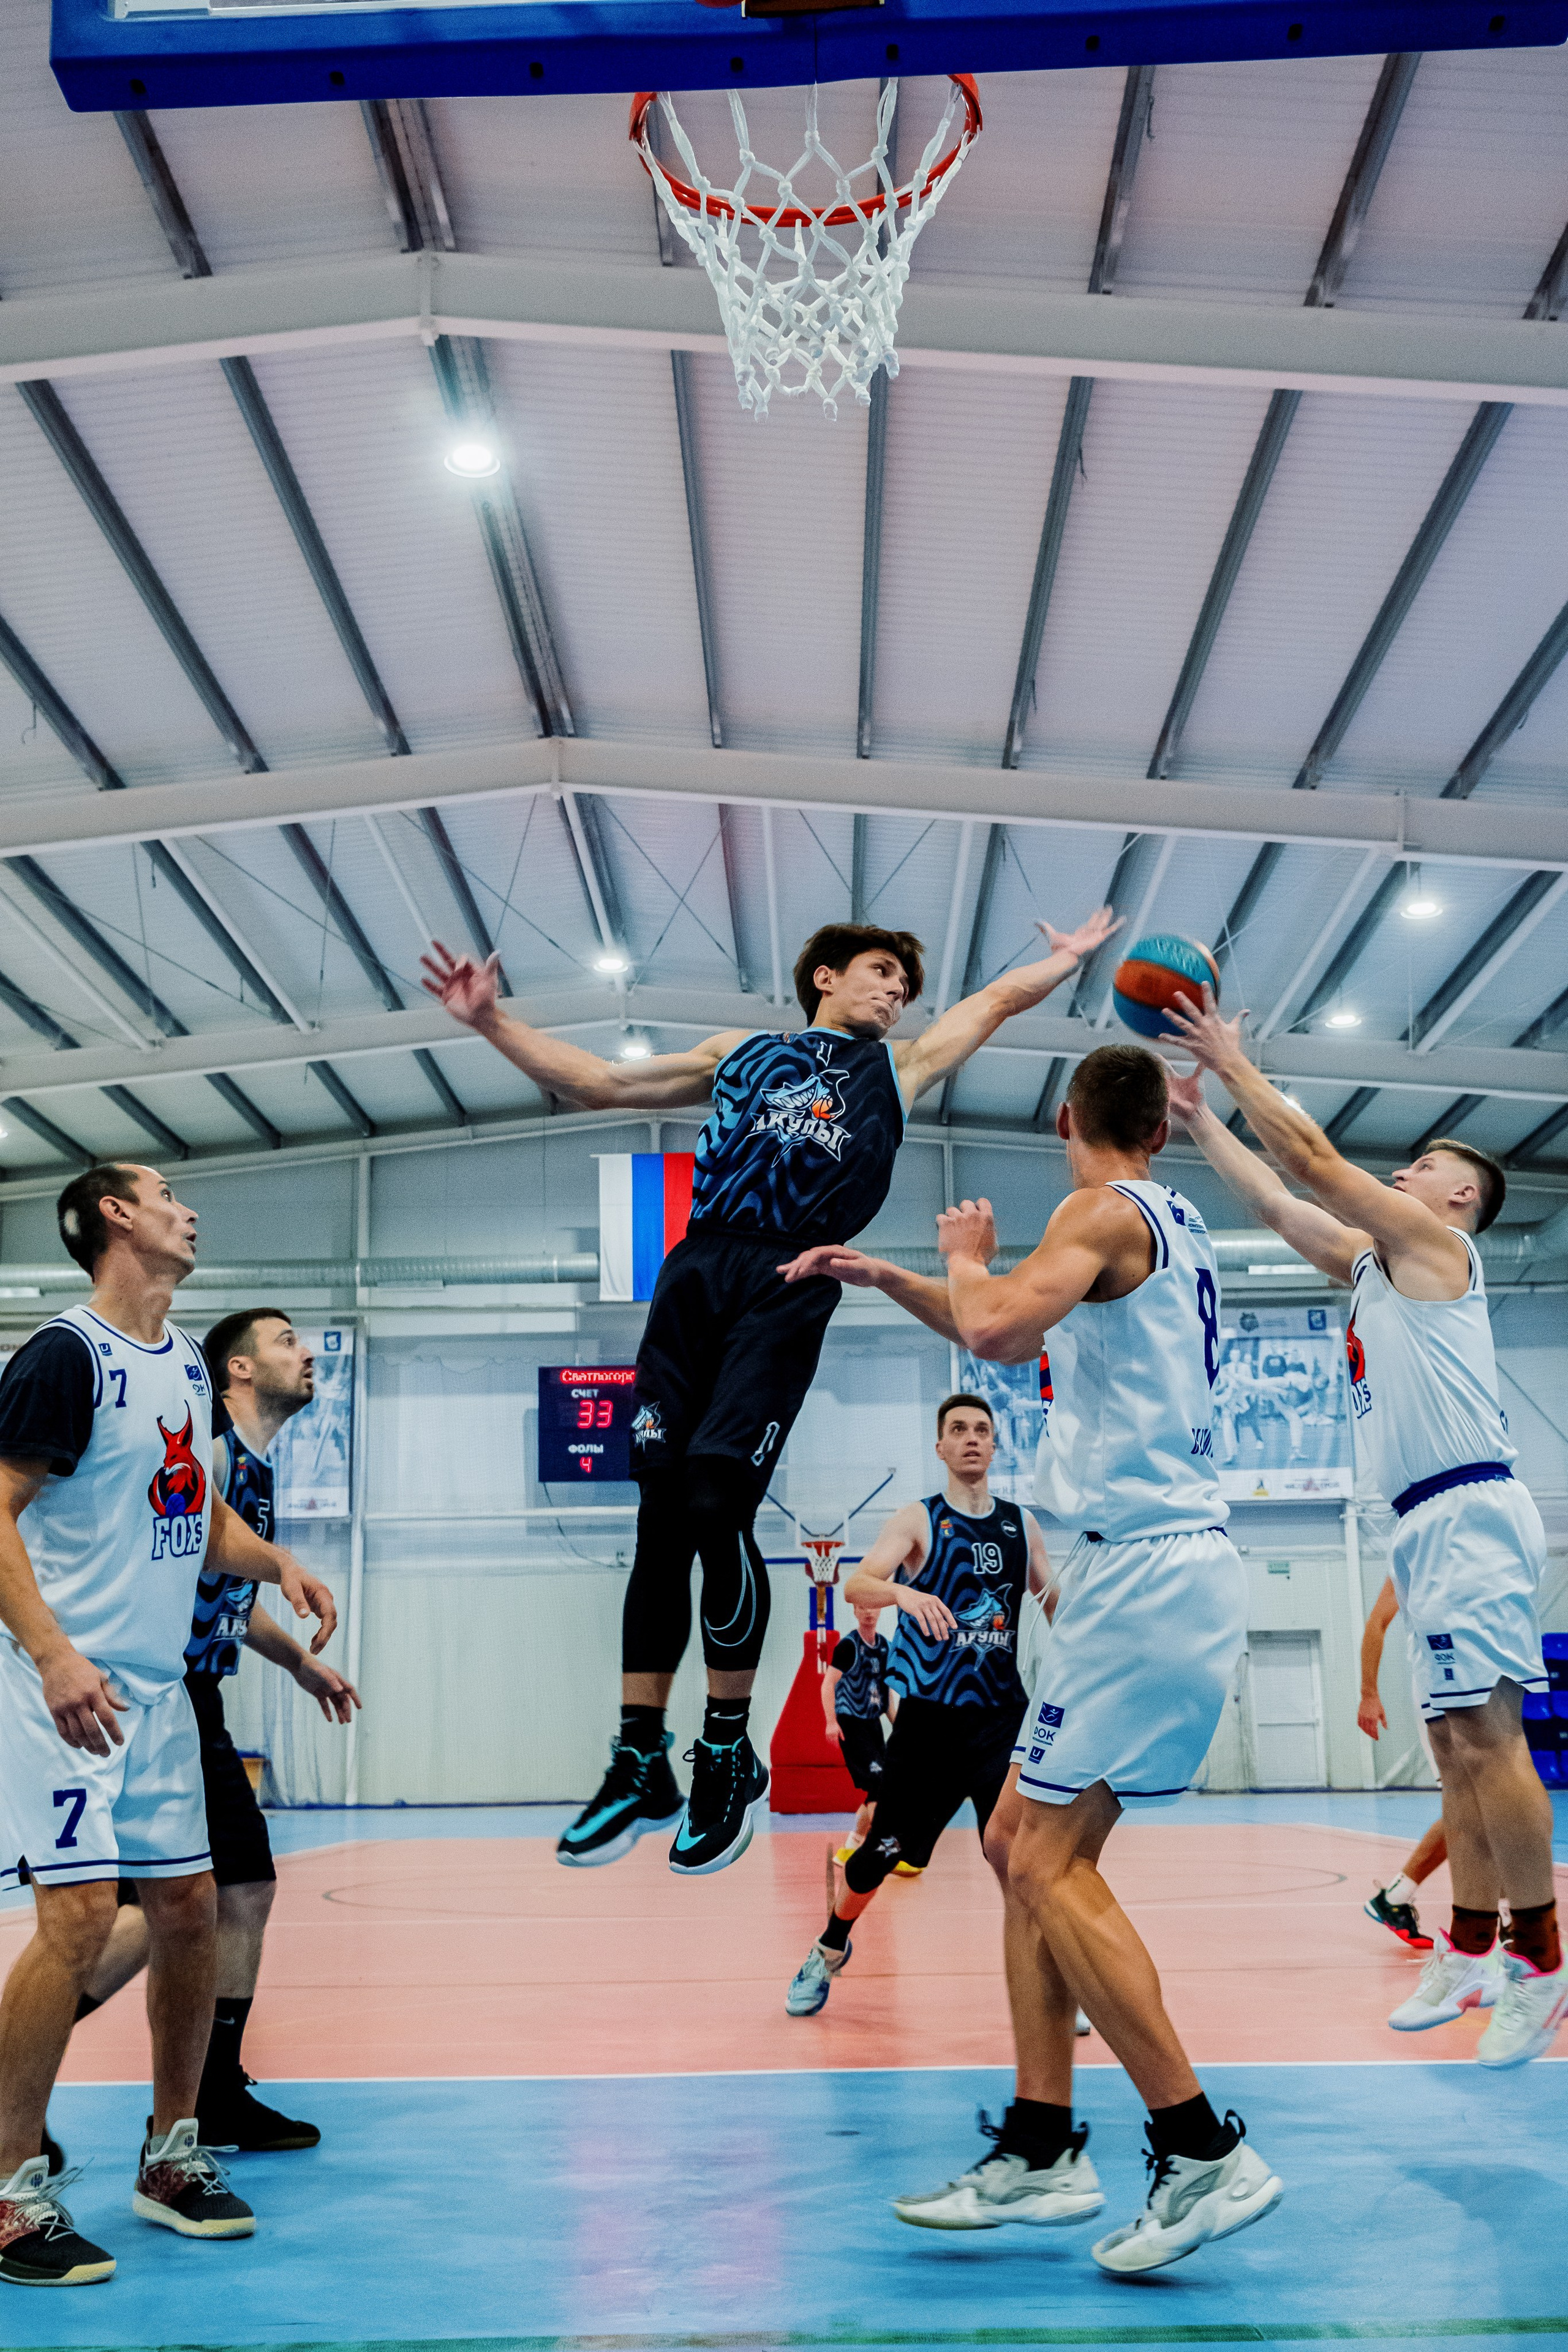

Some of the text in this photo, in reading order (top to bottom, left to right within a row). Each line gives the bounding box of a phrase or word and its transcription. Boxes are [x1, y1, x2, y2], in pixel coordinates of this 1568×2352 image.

[751, 1111, 843, 1150] АКУЛЫ
[108, 1368, 127, 1408] 7
[571, 1388, 599, 1398] СЧЕТ
[577, 1400, 614, 1428] 33
[568, 1444, 604, 1454] ФОЛЫ
[579, 1457, 593, 1474] 4
[971, 1542, 1003, 1575] 19
[53, 1788, 87, 1849] 7
